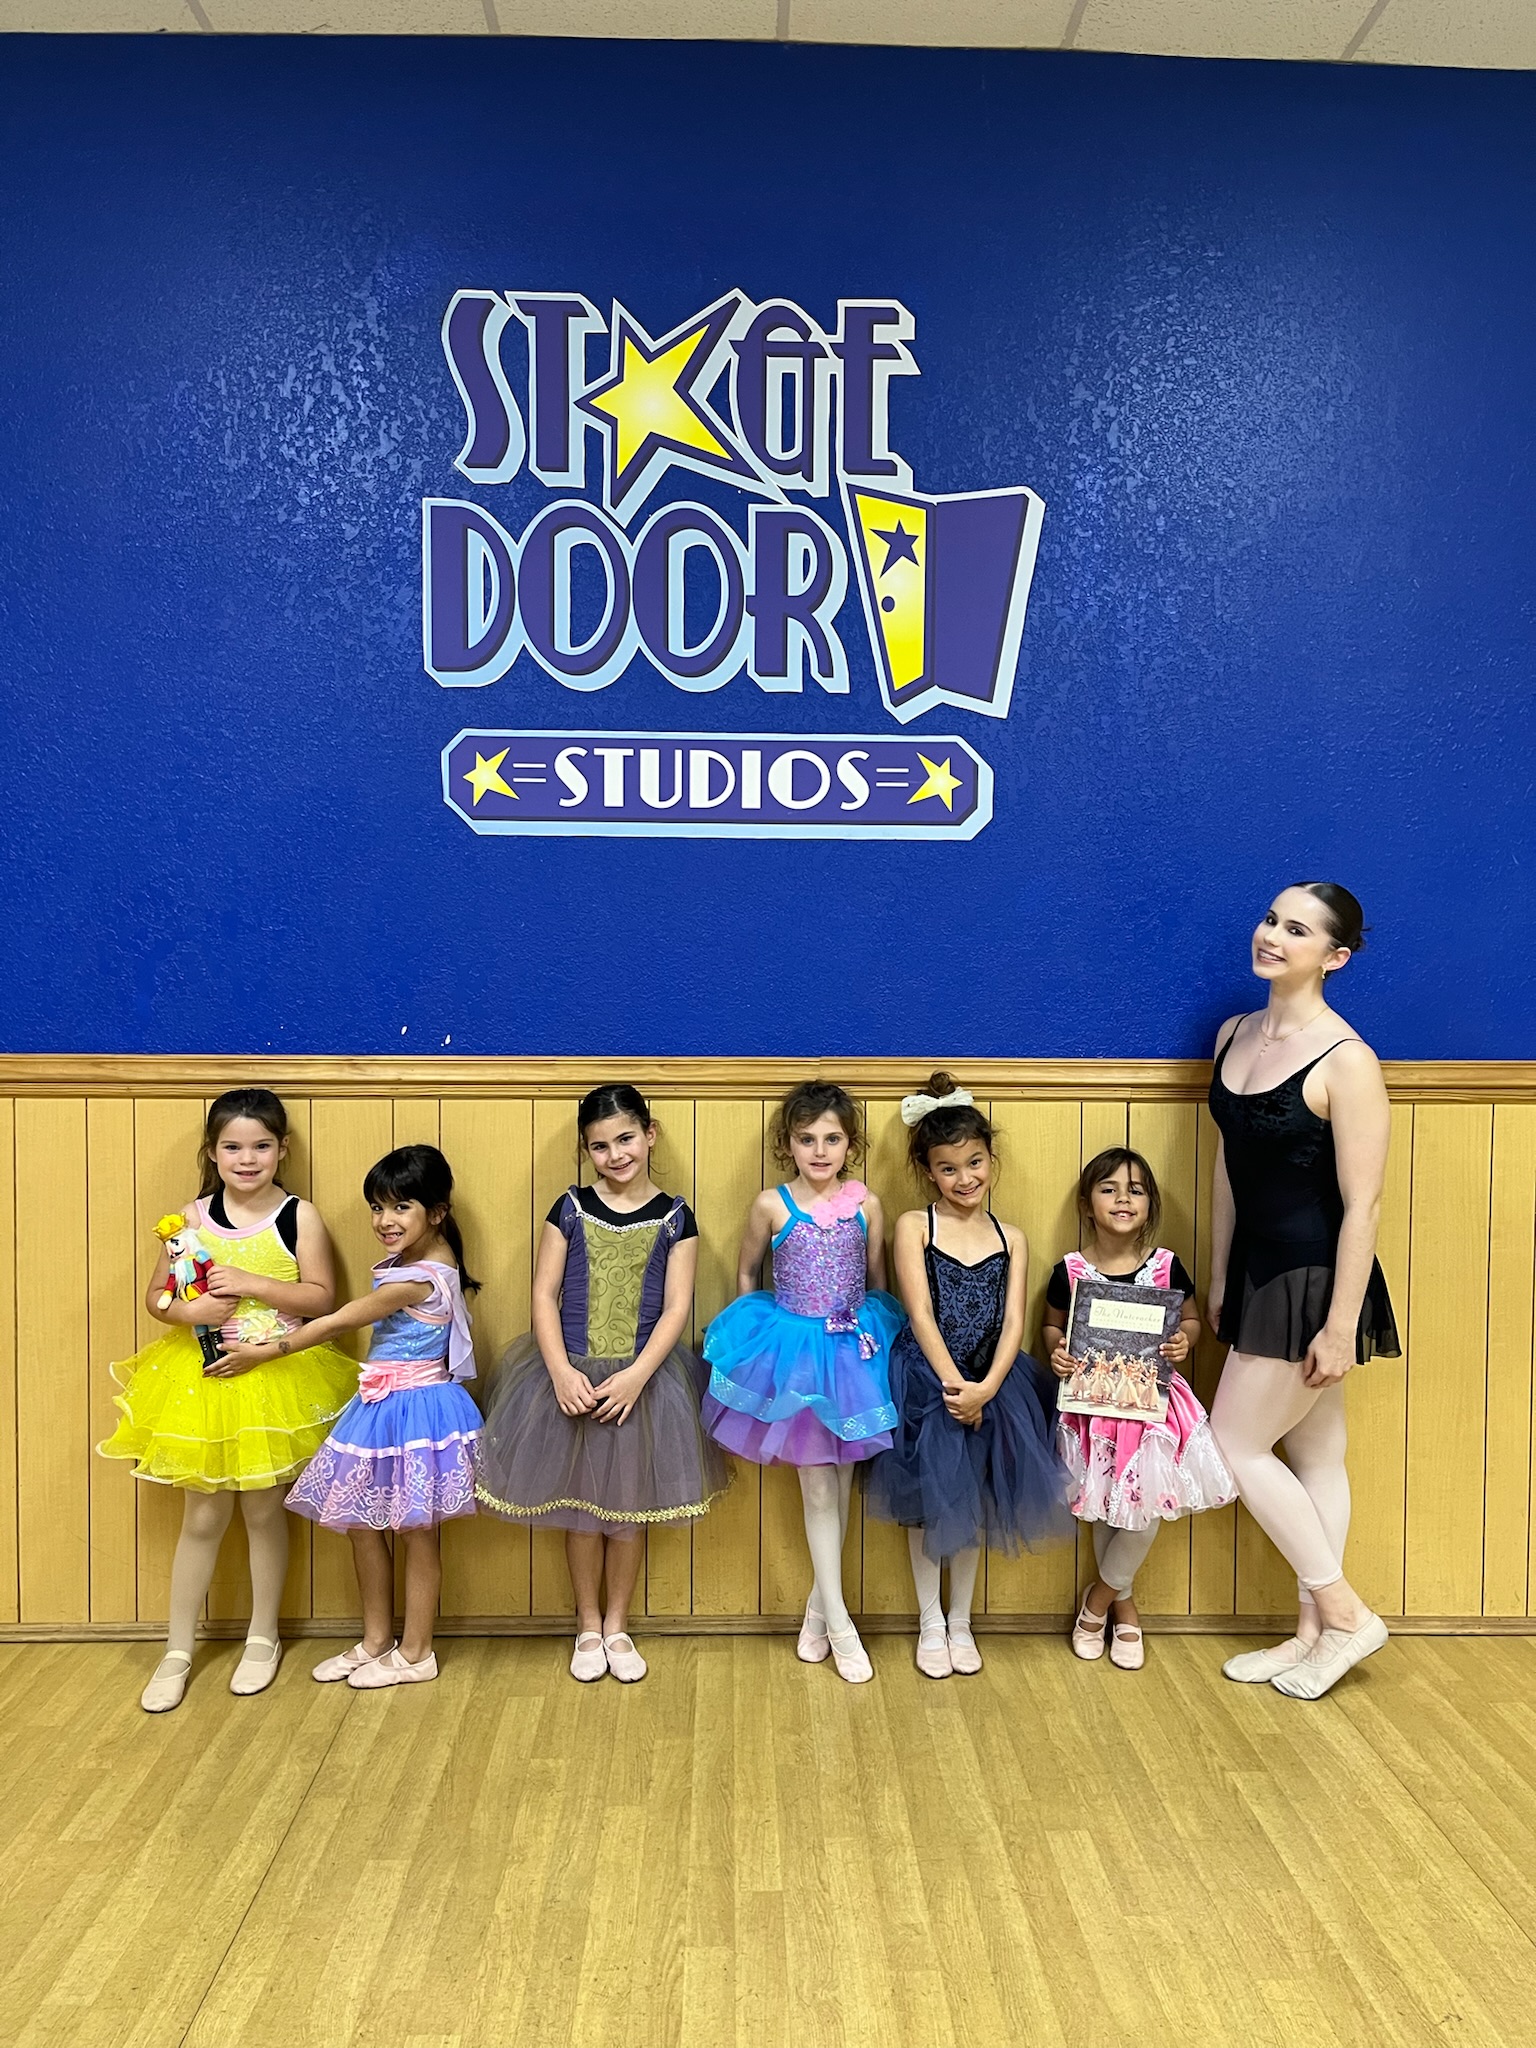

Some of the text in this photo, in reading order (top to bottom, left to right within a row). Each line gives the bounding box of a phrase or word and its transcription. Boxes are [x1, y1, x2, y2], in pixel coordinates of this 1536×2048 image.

[422, 497, 850, 694] DOOR
[553, 746, 871, 811] STUDIOS
[1094, 1305, 1111, 1318] The
[1112, 1308, 1161, 1323] Nutcracker
